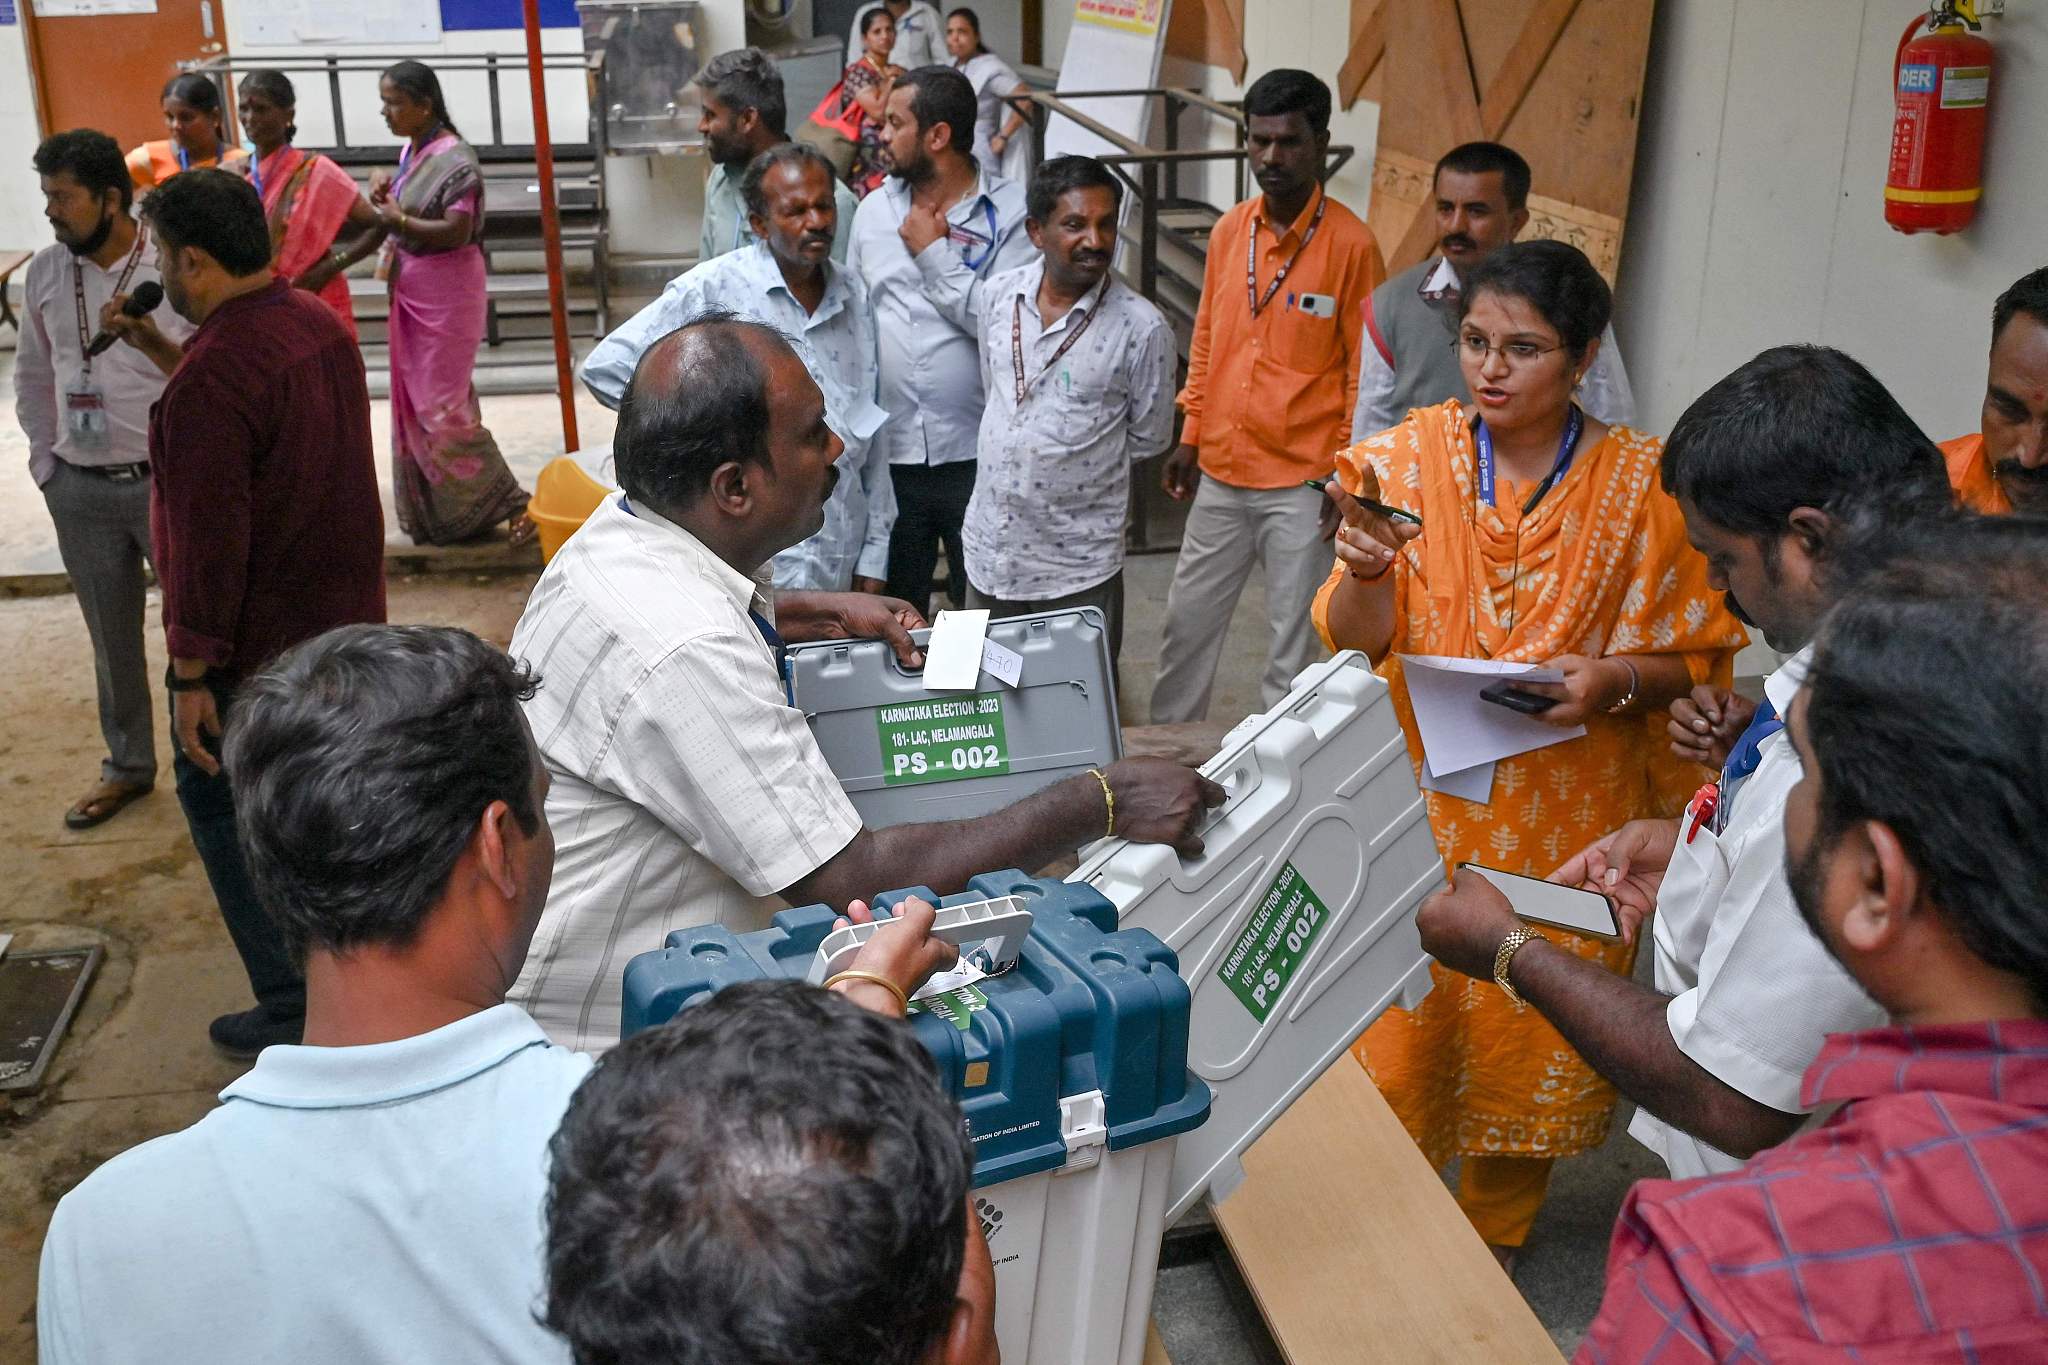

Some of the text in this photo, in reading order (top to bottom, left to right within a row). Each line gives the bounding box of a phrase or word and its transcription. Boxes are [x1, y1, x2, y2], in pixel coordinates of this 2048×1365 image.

[881, 705, 932, 724] KARNATAKA
[933, 700, 975, 719] ELECTION
[892, 723, 995, 747] 181- LAC, NELAMANGALA
[893, 752, 928, 777] PS
[951, 744, 1000, 771] 002
[1222, 928, 1260, 981] KARNATAKA
[1254, 887, 1282, 932] ELECTION
[1241, 889, 1304, 988] 181- LAC, NELAMANGALA
[1252, 968, 1280, 1009] PS
[1286, 902, 1321, 953] 002
[952, 987, 980, 1005] TION
[969, 1132, 993, 1143] RATION
[1002, 1126, 1018, 1135] INDIA
[1018, 1120, 1040, 1131] LIMITED
[1001, 1254, 1019, 1264] INDIA
